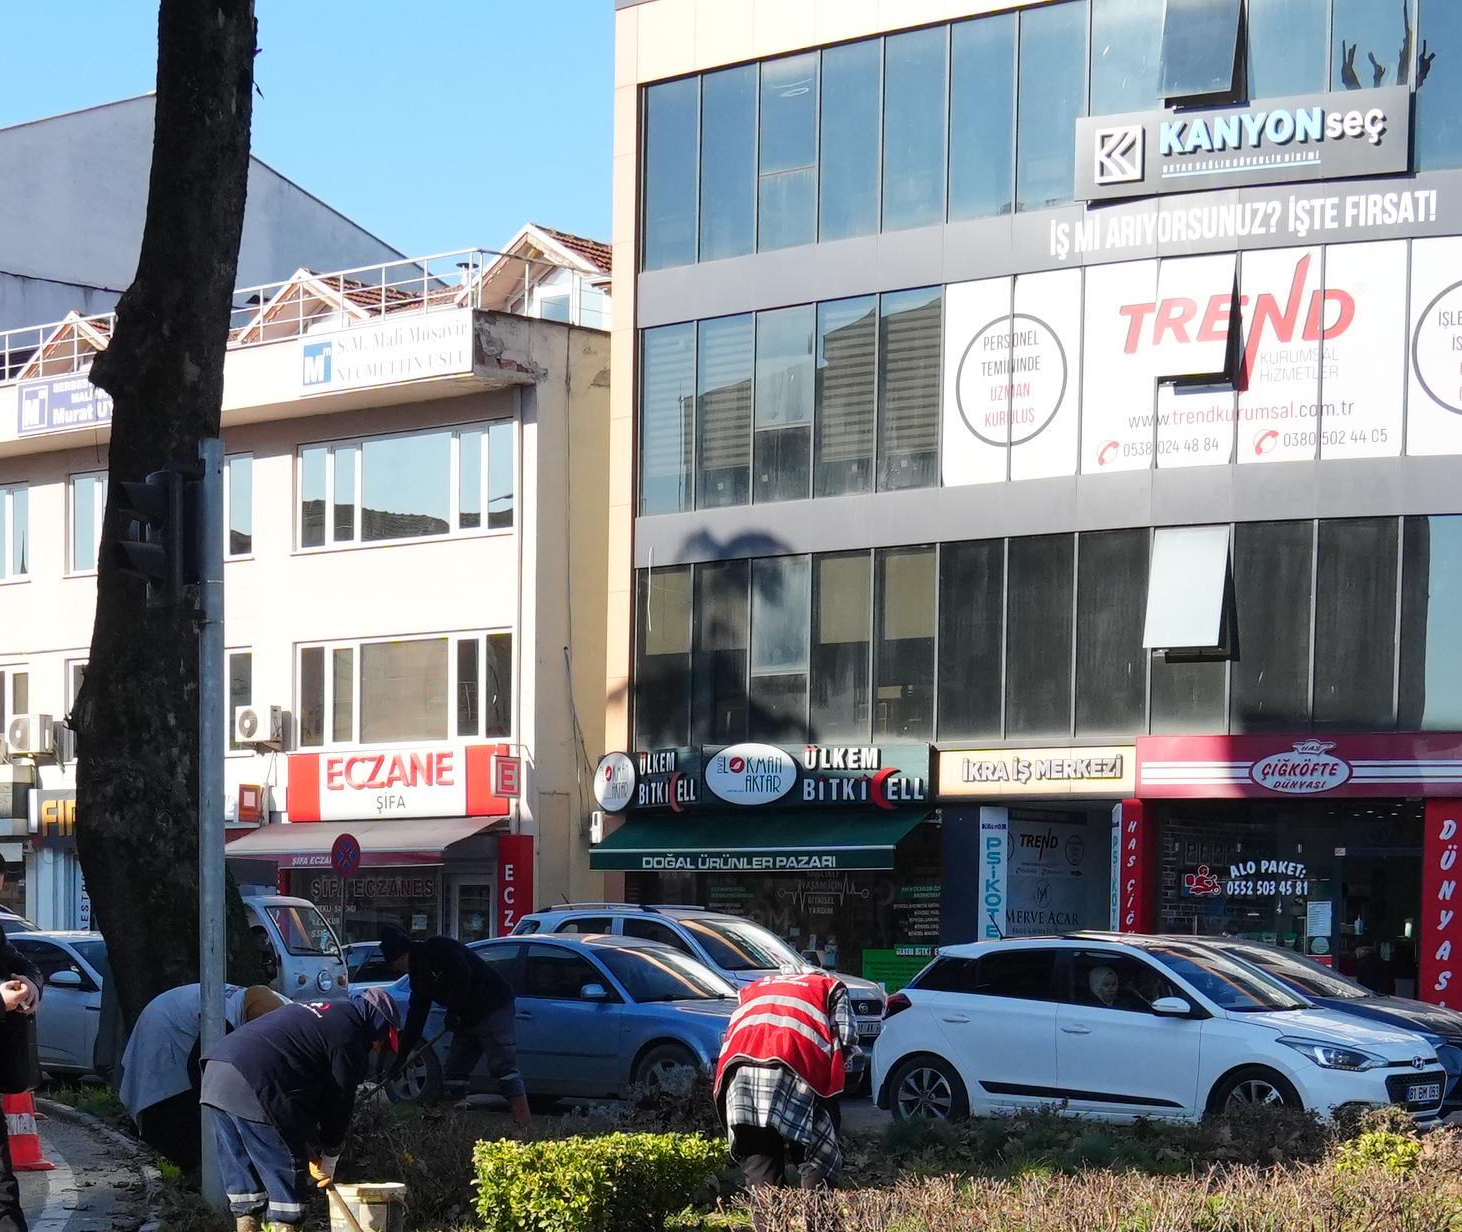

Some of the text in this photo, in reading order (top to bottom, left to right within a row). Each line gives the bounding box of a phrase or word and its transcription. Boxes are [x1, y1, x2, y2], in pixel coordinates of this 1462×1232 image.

[1050, 189, 1437, 260] İŞ Mİ ARIYORSUNUZ? İŞTE FIRSAT!
[1119, 252, 1356, 395] TREND
[983, 329, 1040, 352] PERSONEL
[1259, 348, 1339, 366] KURUMSAL
[52, 378, 93, 394] SERBES
[990, 381, 1031, 402] UZMAN
[52, 403, 94, 425] Murat
[984, 407, 1035, 428] KURULUŞ
[1128, 400, 1355, 429] www.trendkurumsal.com.tr
[1123, 438, 1219, 457] 0538 024 48 84
[1282, 428, 1388, 448] 0380 502 44 05
[639, 752, 675, 775] ÜLKEM
[724, 755, 783, 774] LOKMAN
[803, 746, 880, 770] ÜLKEM
[1260, 757, 1340, 779] ÇİĞKÖFTE
[326, 751, 455, 791] ECZANE
[961, 754, 1124, 784] İKRA İŞ MERKEZİ
[745, 774, 782, 793] AKTAR
[1272, 777, 1327, 790] DÜNYASI
[375, 793, 406, 815] ŞİFA
[1018, 827, 1059, 861] TREND
[642, 851, 837, 870] DOĞAL ÜRÜNLER PAZARI
[1229, 860, 1308, 879] ALO PAKET:
[353, 877, 437, 898] ECZANES
[1125, 820, 1138, 935] HAS ÇİĞ
[1226, 880, 1308, 896] 0552 503 45 81
[503, 864, 515, 937] ECZ
[807, 906, 834, 915] YARDIM
[1006, 909, 1080, 926] MERVE ACAR
[1434, 819, 1458, 1008] DÜNYAS
